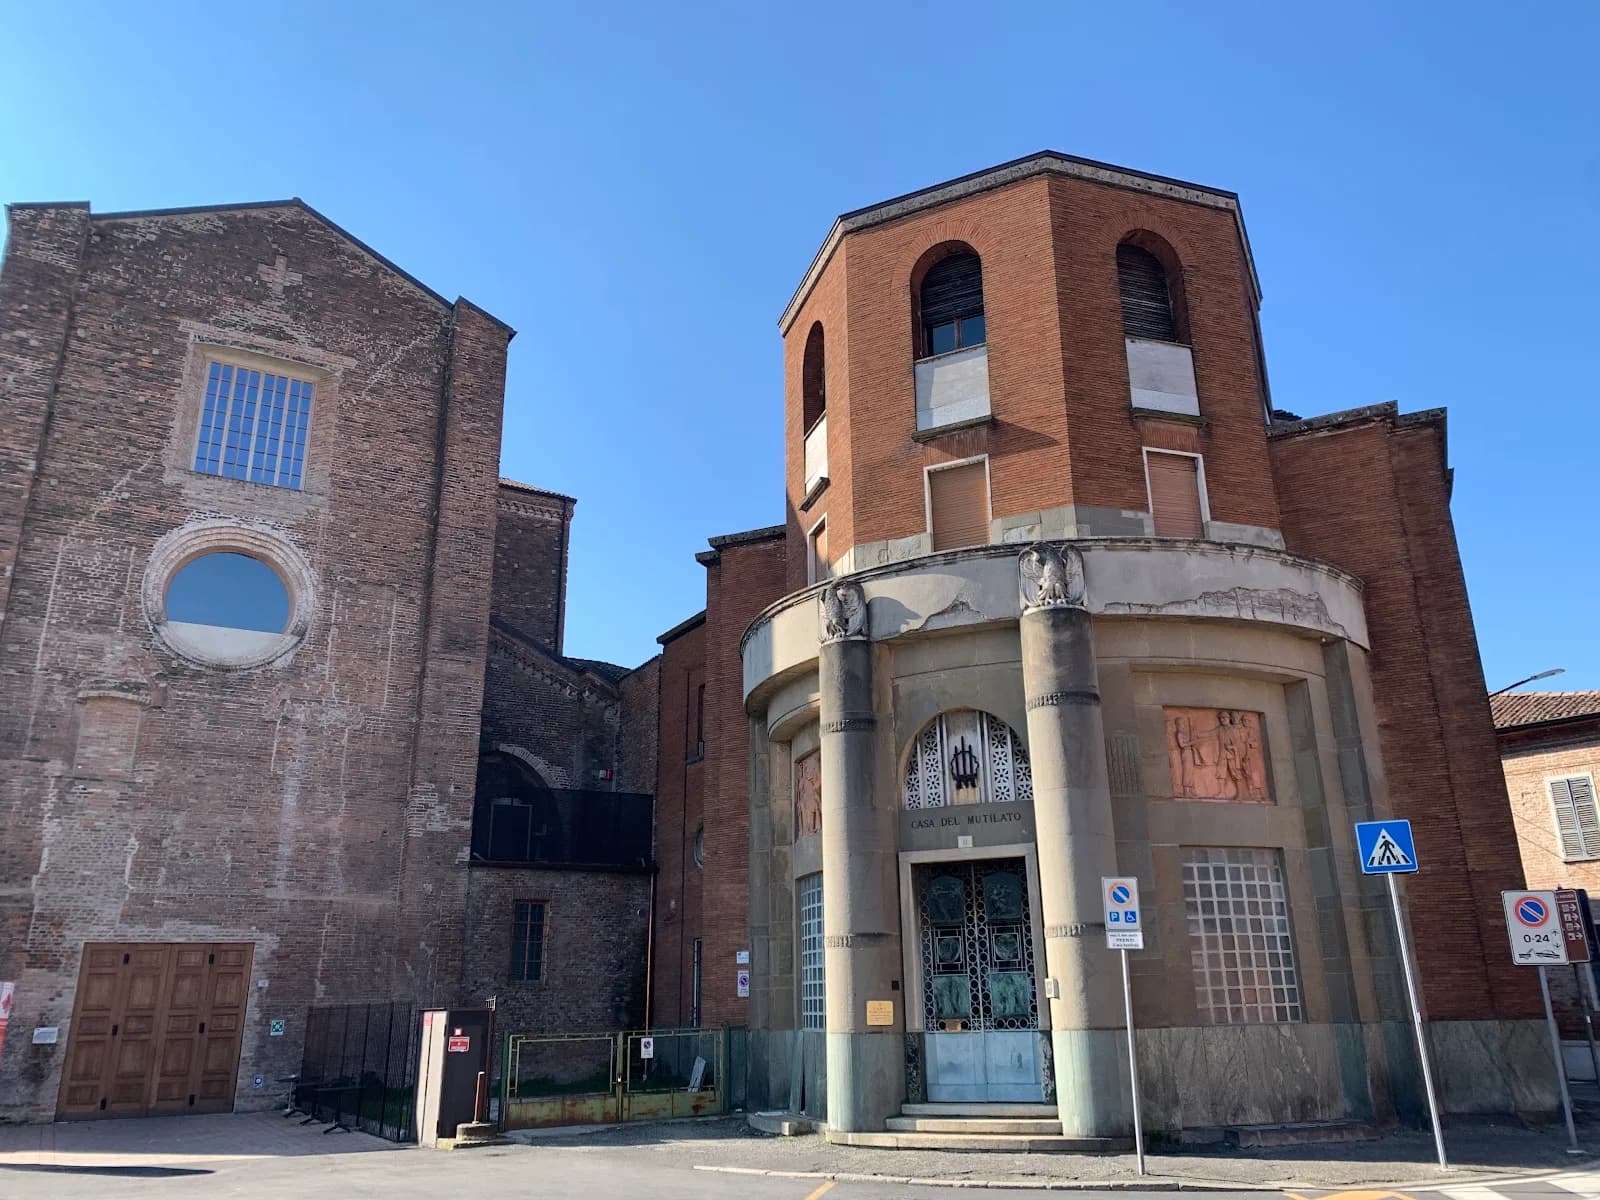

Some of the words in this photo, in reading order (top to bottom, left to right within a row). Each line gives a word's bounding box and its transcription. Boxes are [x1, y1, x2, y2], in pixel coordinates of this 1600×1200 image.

[911, 820, 935, 829] CASA
[941, 817, 960, 826] DEL
[967, 812, 1021, 824] MUTILATO
[1523, 934, 1550, 943] 0-24
